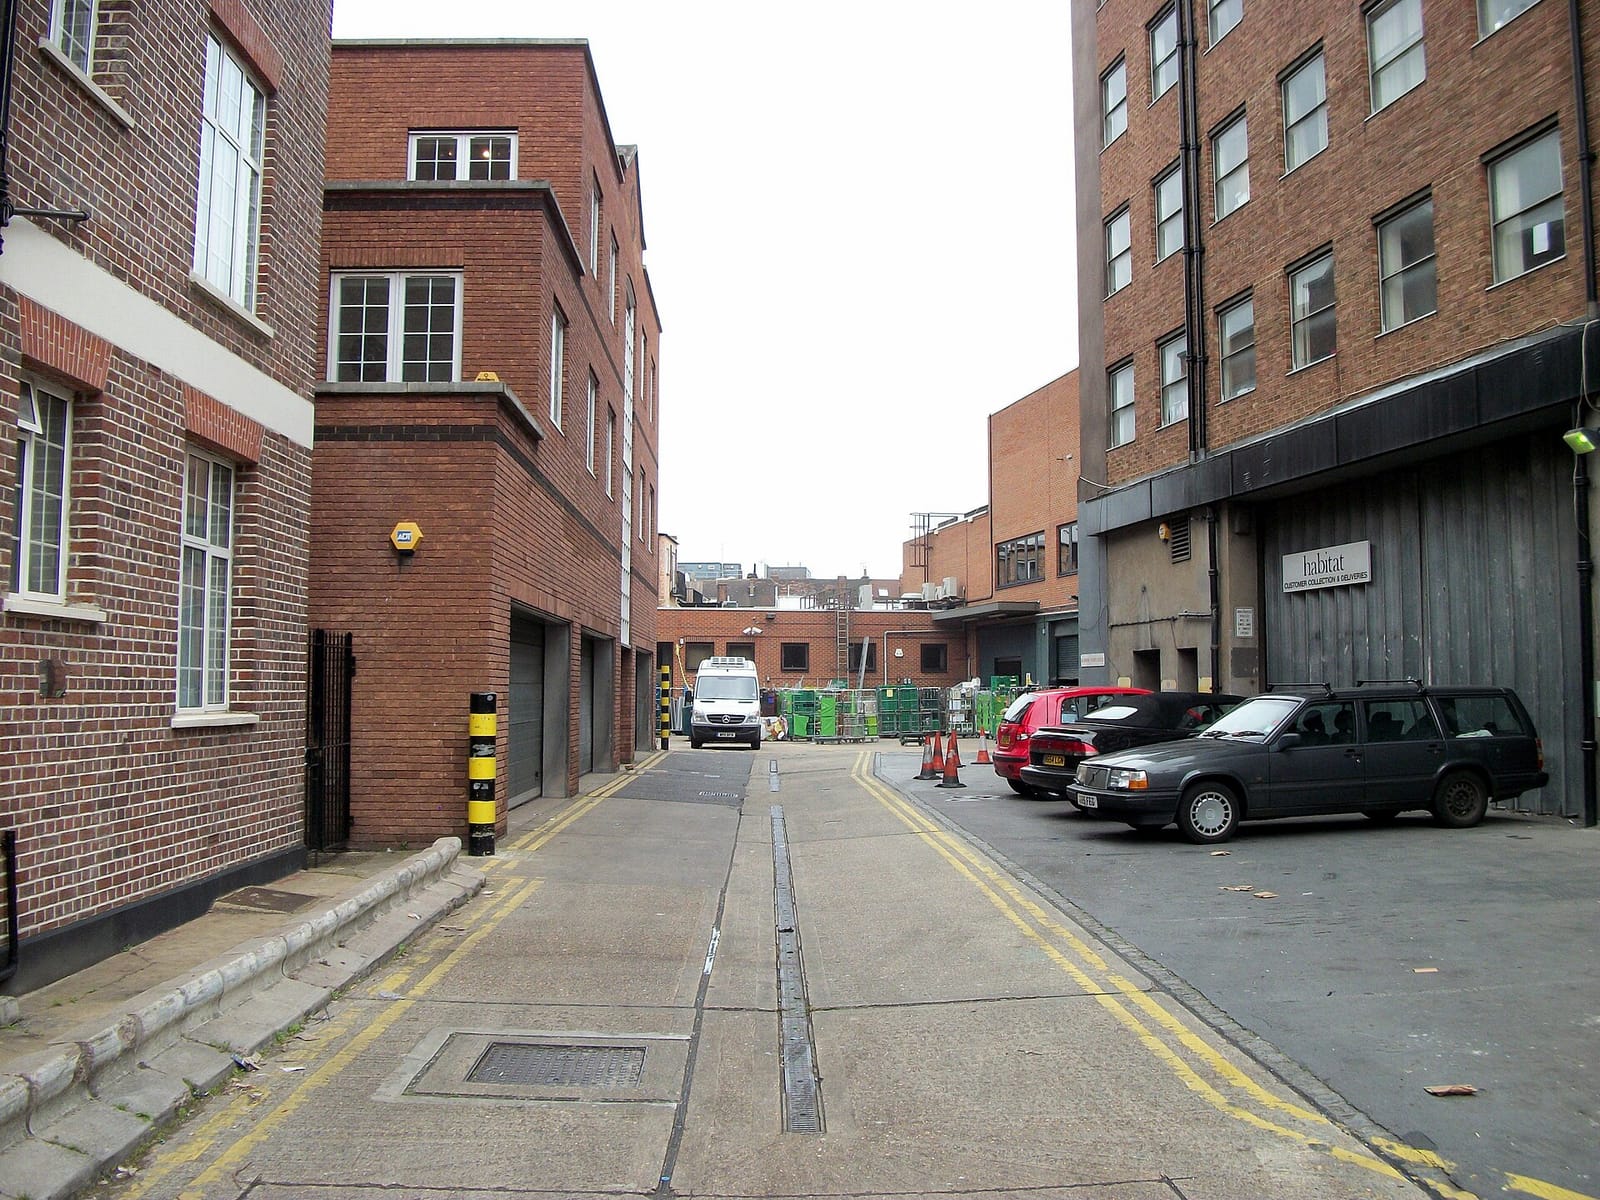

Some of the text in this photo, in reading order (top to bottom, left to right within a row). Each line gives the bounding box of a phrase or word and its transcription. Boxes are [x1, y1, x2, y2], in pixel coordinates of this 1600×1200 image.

[397, 531, 412, 541] ADT
[1303, 551, 1345, 576] habitat
[1284, 580, 1307, 589] CUSTOMER
[1308, 576, 1336, 586] COLLECTION
[1341, 571, 1368, 581] DELIVERIES
